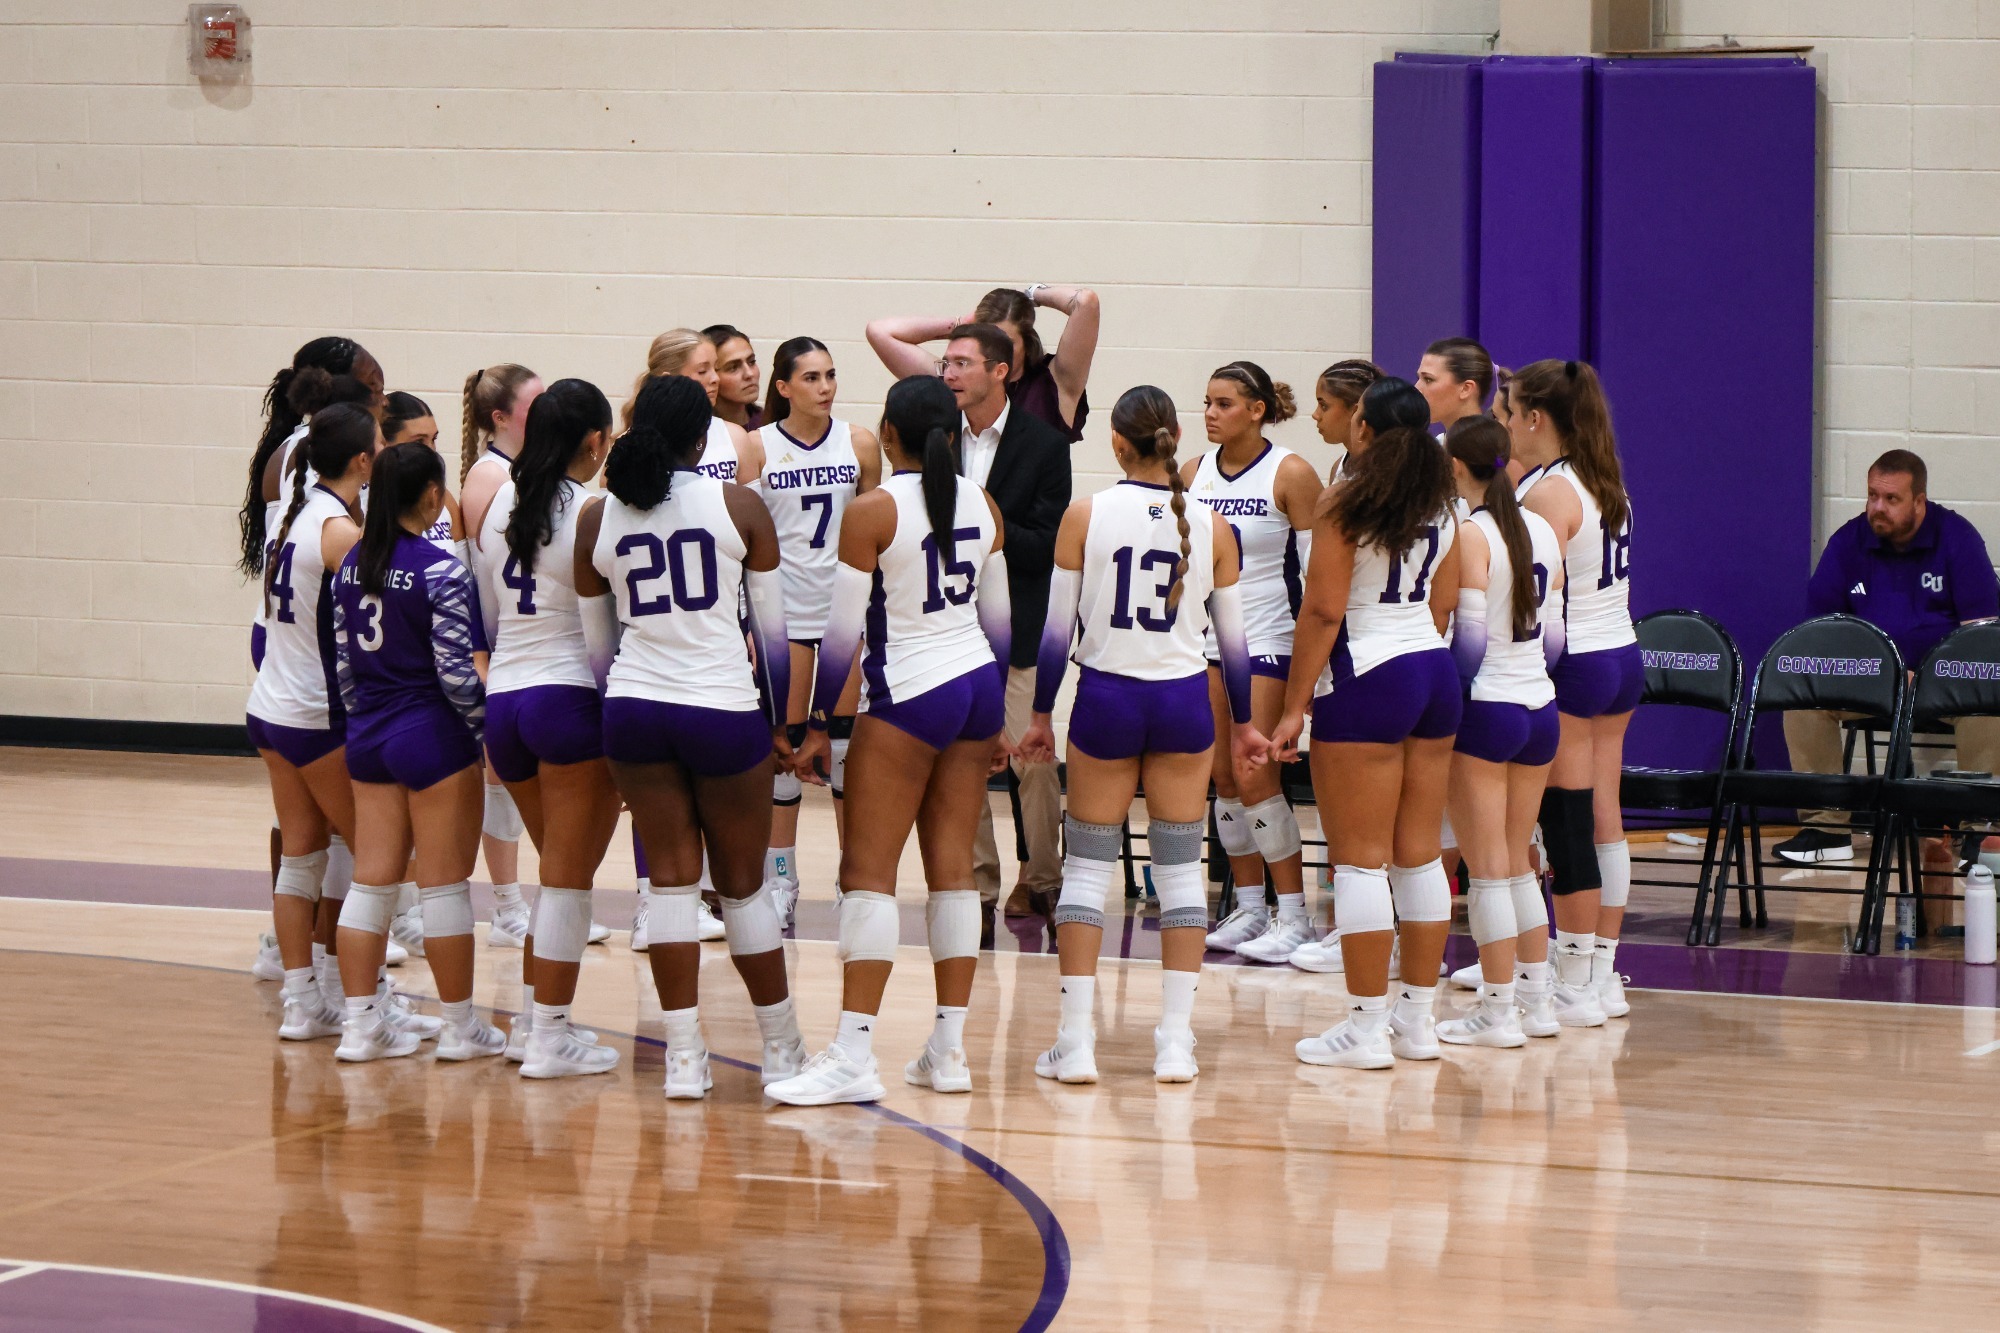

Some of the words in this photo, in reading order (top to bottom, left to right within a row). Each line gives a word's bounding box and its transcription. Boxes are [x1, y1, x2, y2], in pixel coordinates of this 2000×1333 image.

[768, 465, 856, 490] CONVERSE
[801, 493, 833, 549] 7
[502, 548, 537, 615] 4
[615, 528, 719, 617] 20
[921, 526, 981, 614] 15
[1110, 546, 1183, 632] 13
[1921, 572, 1944, 592] CU
[357, 593, 384, 651] 3
[1640, 649, 1721, 671] NVERSE
[1777, 655, 1882, 676] CONVERSE
